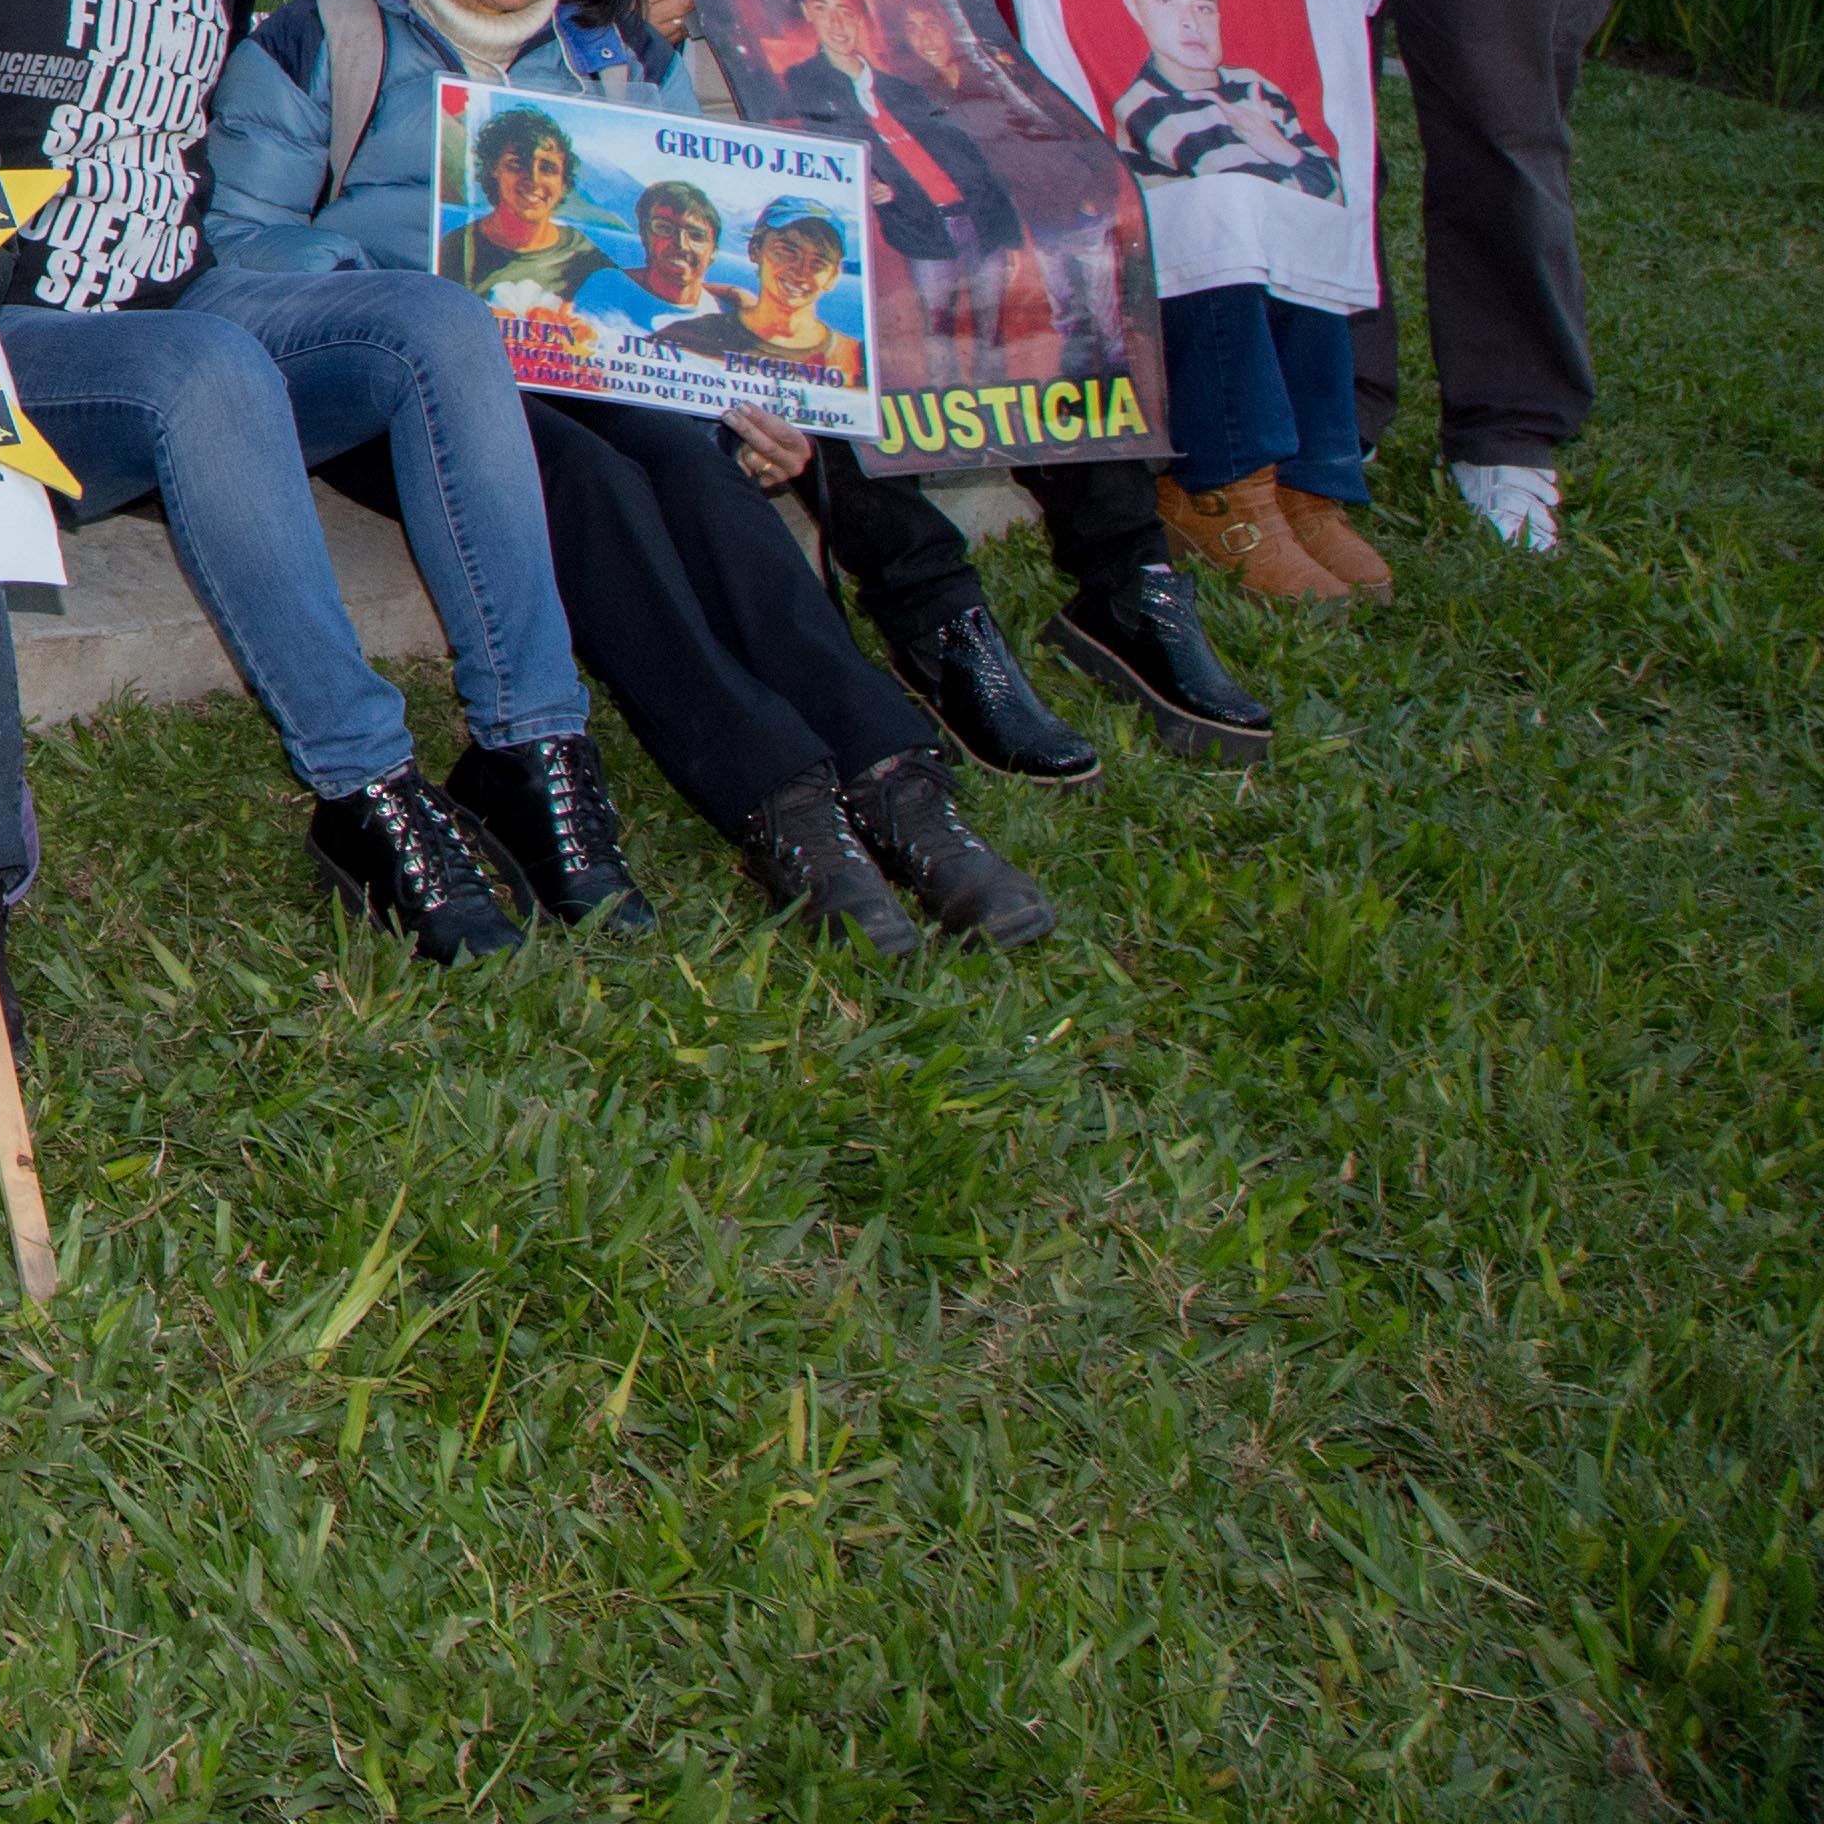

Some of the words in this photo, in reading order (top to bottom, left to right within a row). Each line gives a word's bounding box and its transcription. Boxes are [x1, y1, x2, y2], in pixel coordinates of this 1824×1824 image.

[655, 128, 763, 169] GRUPO
[769, 146, 852, 183] J.E.N.
[18, 196, 198, 282] ODEMOS
[618, 334, 682, 363] JUAN
[723, 350, 845, 388] EUGENIO
[533, 366, 650, 394] IMPUNIDAD
[654, 384, 695, 402] QUE
[699, 392, 724, 409] DA
[609, 358, 637, 373] DE
[641, 362, 726, 389] DELITOS
[730, 378, 800, 399] VIALES
[878, 377, 1150, 455] JUSTICIA
